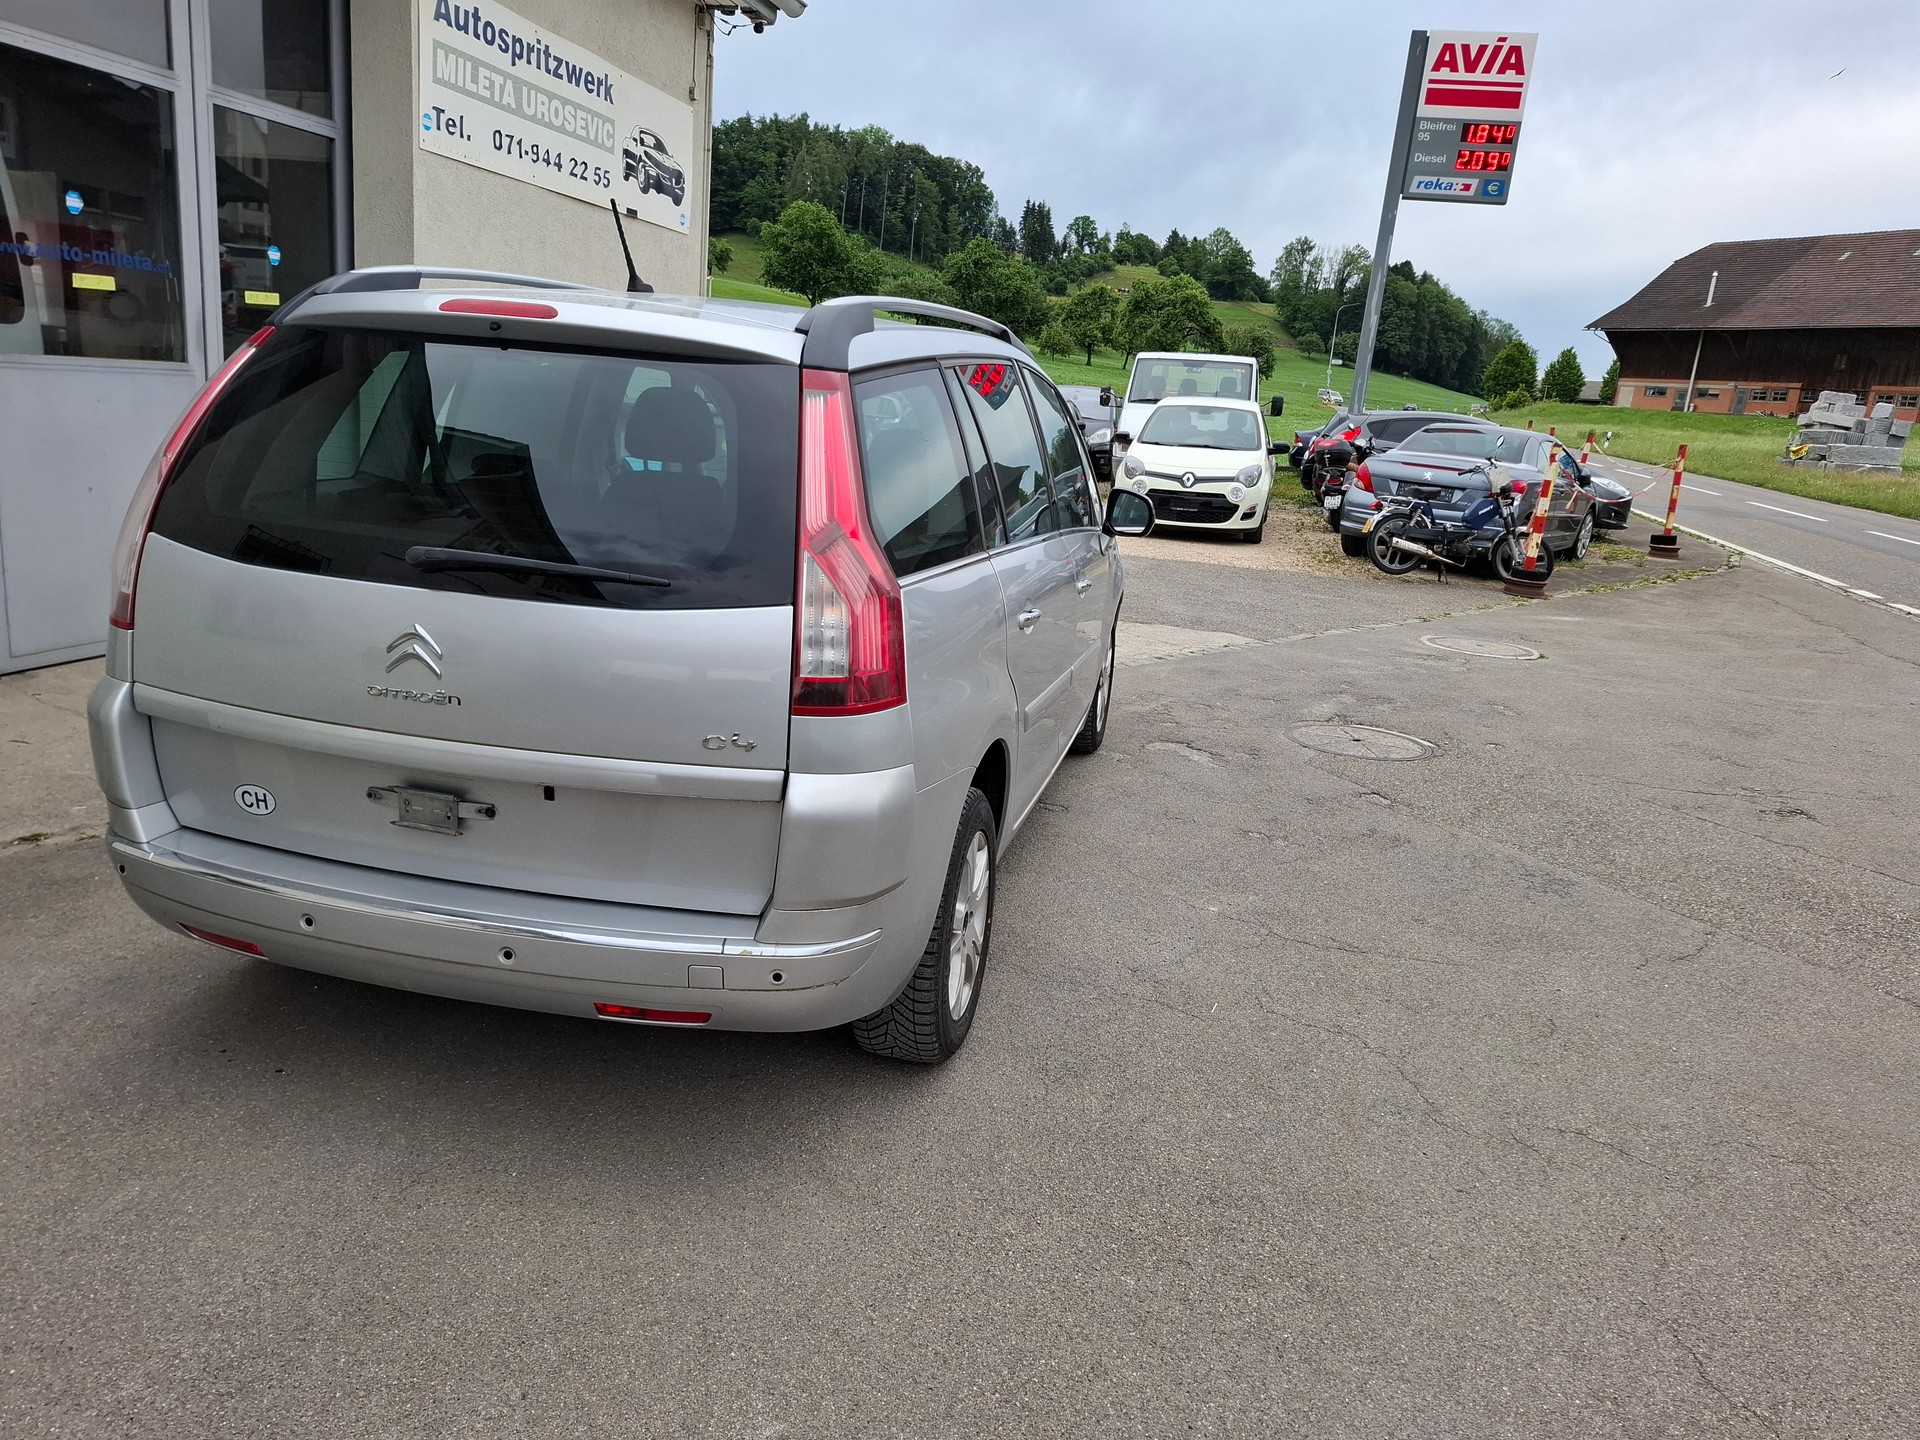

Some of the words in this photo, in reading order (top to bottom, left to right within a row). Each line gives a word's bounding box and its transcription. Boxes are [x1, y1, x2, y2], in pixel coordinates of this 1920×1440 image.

[433, 0, 615, 105] Autospritzwerk
[1430, 36, 1526, 76] AVIA
[436, 48, 517, 109] MILETA
[522, 87, 615, 148] UROSEVIC
[1417, 131, 1431, 141] 95
[1419, 120, 1457, 131] Bleifrei
[432, 106, 472, 141] Tel.
[492, 129, 563, 172] 071-944
[568, 157, 588, 182] 22
[593, 166, 611, 189] 55
[1414, 153, 1447, 163] Diesel
[702, 731, 758, 752] C4
[241, 790, 269, 811] CH
